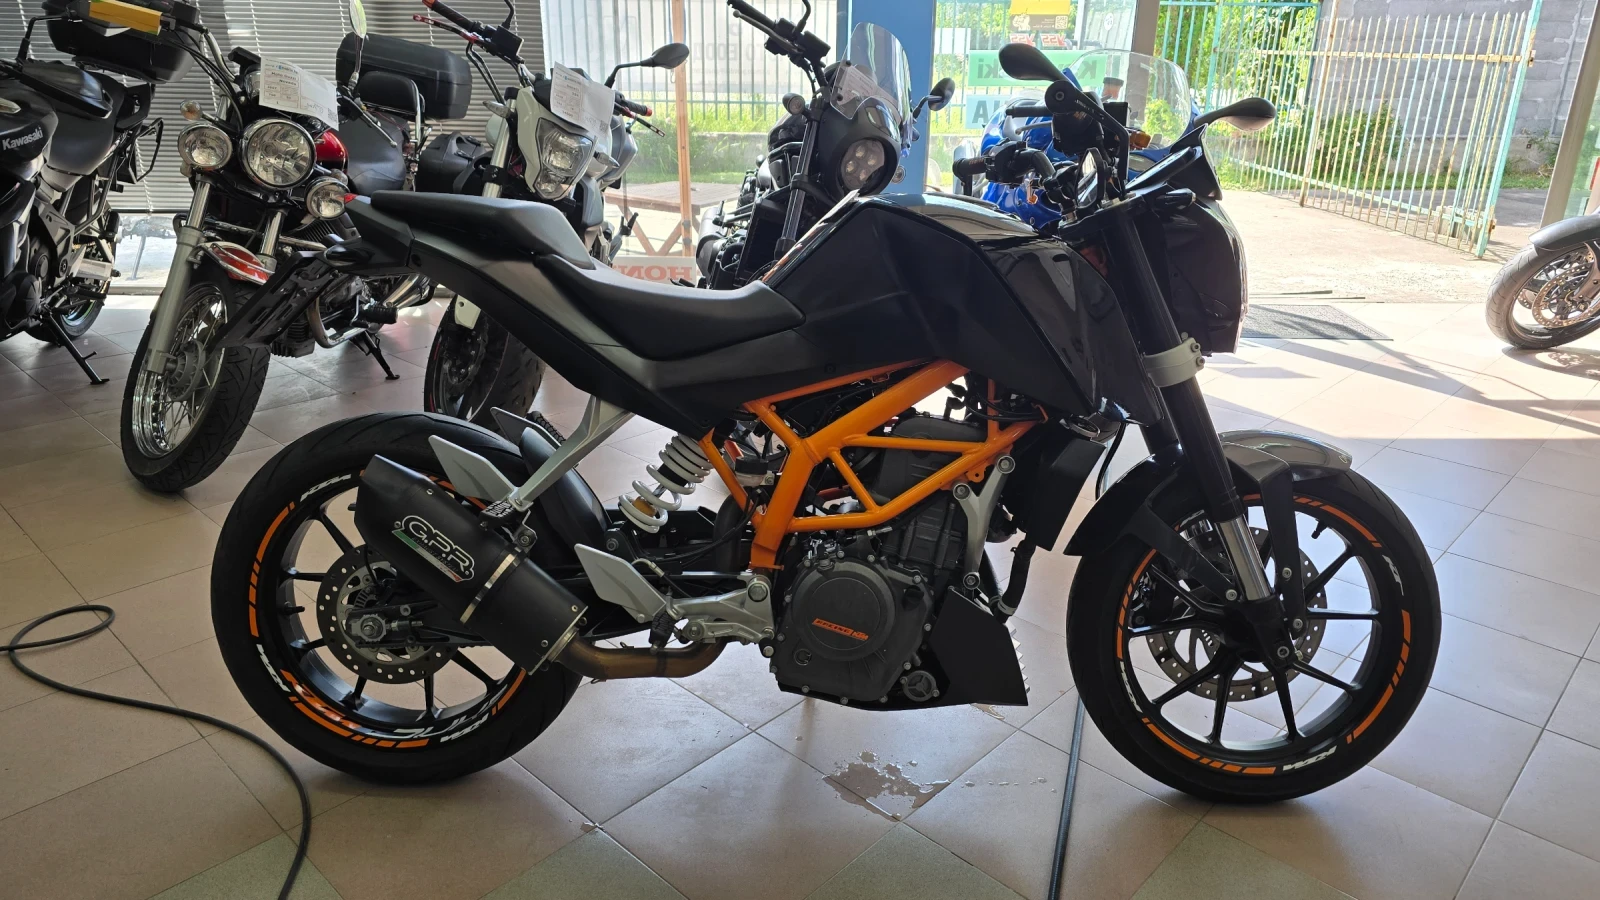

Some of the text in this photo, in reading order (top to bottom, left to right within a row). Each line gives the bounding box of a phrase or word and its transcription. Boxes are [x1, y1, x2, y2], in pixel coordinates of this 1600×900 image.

[2, 126, 43, 151] Kawasaki
[299, 473, 352, 503] KTM
[256, 643, 291, 692] KTM
[1119, 660, 1144, 714] KTM
[440, 712, 490, 742] KTM
[1282, 745, 1338, 772] KTM
